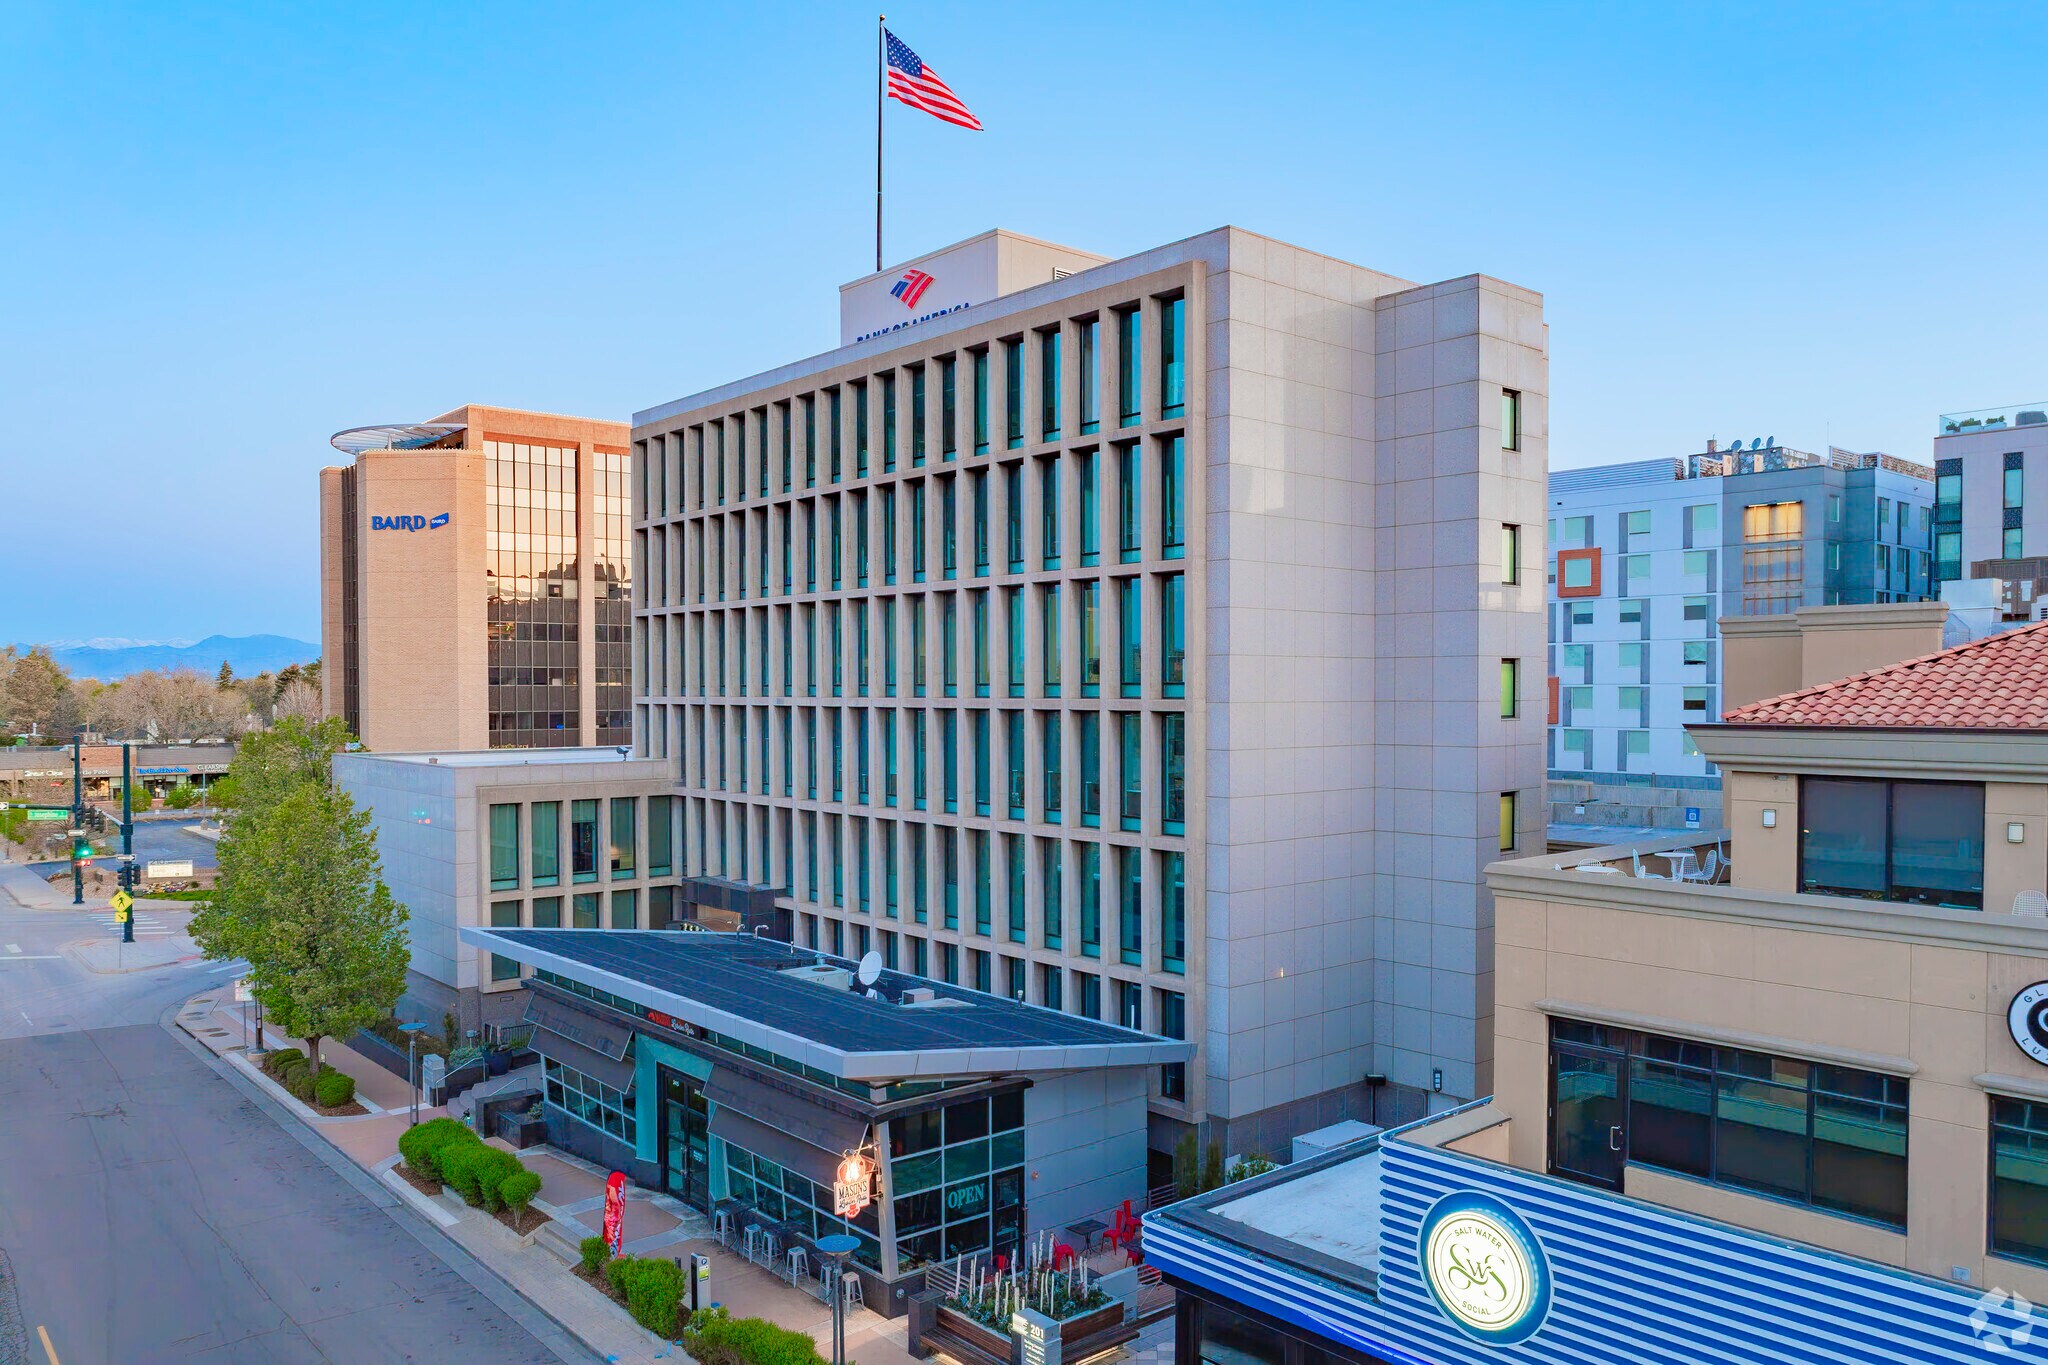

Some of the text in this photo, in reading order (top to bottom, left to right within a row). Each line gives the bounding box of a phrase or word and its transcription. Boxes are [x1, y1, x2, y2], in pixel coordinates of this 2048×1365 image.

[372, 515, 426, 532] BAIRD
[948, 1183, 985, 1209] OPEN
[1454, 1226, 1503, 1249] SALT WATER
[1461, 1300, 1492, 1316] SOCIAL
[1030, 1323, 1044, 1339] 201
